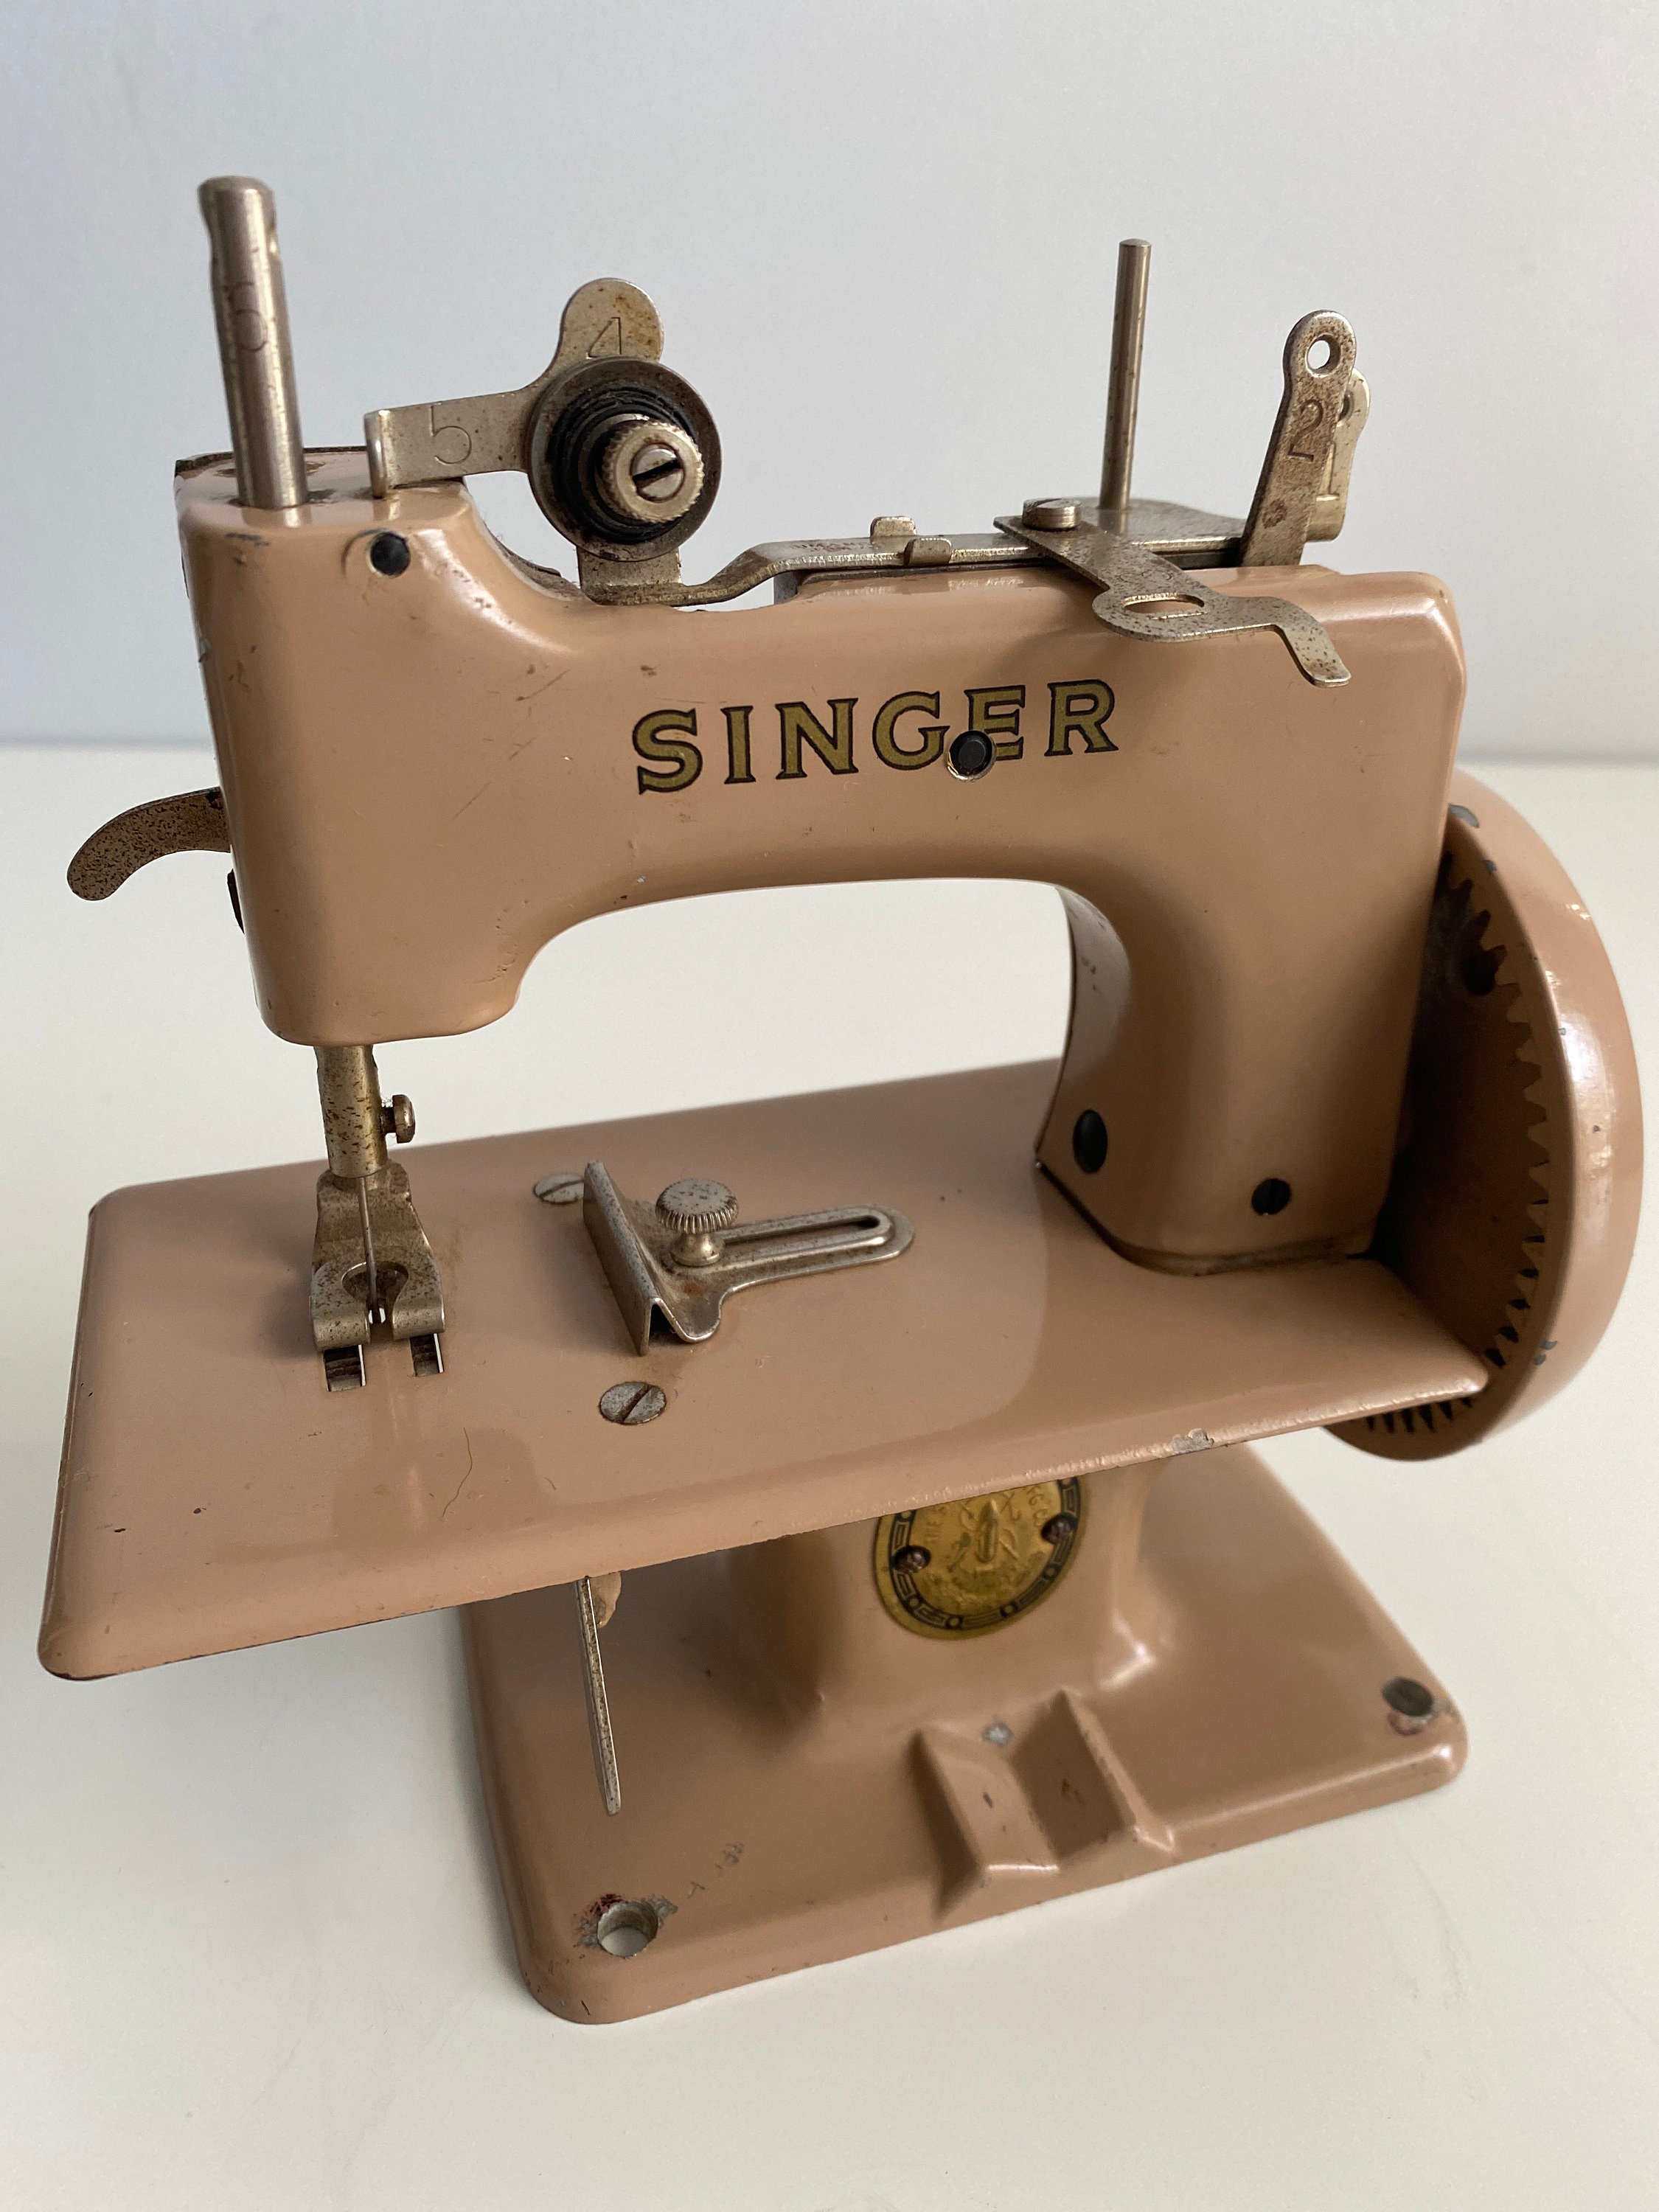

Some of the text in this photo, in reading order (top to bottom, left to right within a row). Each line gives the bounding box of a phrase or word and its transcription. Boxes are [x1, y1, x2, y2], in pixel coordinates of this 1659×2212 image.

[588, 316, 623, 359] 4
[428, 403, 473, 466] 5
[1287, 398, 1324, 462] 2
[632, 678, 1119, 795] SINGER
